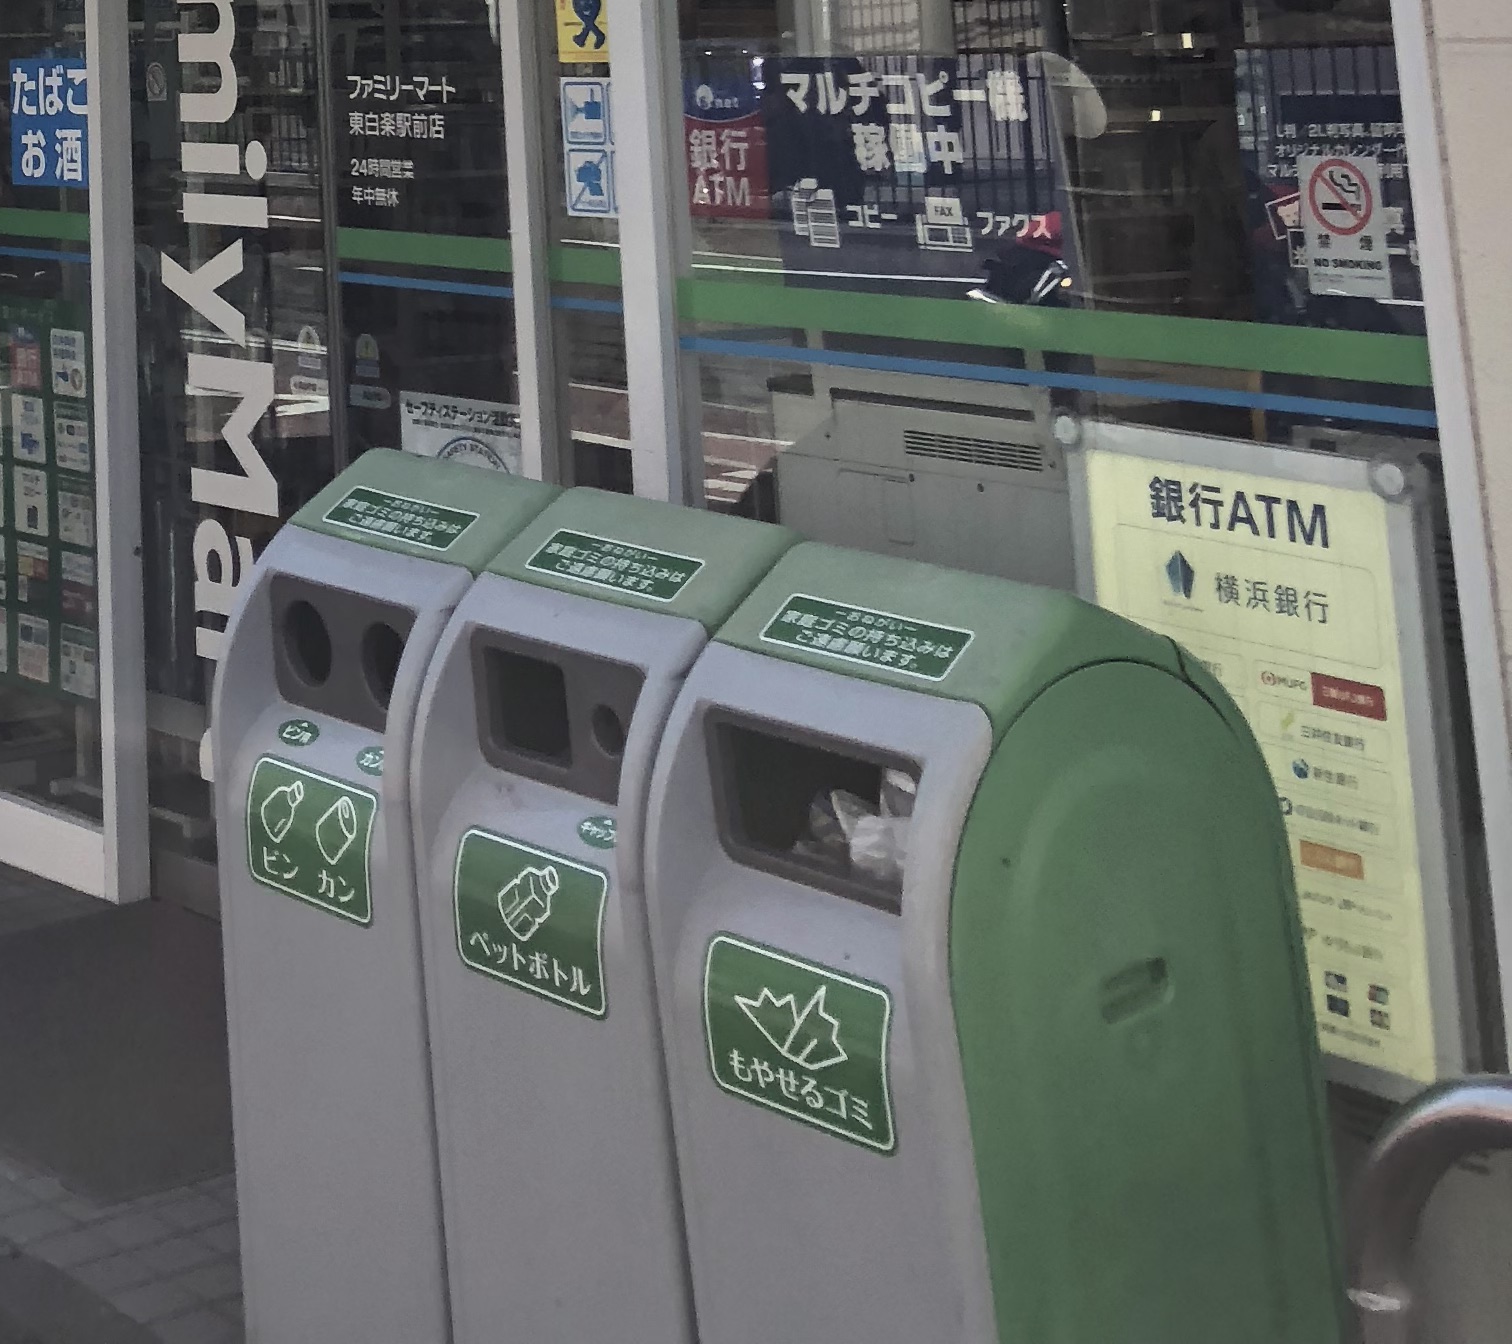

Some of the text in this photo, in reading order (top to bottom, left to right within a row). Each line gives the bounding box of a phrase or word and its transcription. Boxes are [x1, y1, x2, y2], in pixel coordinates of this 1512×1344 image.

[13, 64, 88, 116] たばこ
[346, 75, 456, 104] ファミリーマート
[779, 69, 1029, 123] マルチコピー機
[349, 111, 445, 140] 東白楽駅前店
[21, 129, 83, 182] お酒
[689, 128, 750, 173] 銀行
[851, 122, 965, 175] 稼働中
[350, 158, 415, 180] 24時間営業
[352, 186, 400, 208] 年中無休
[692, 175, 752, 207] ATM
[845, 204, 898, 230] コピー
[932, 204, 954, 218] FAX
[975, 211, 1053, 240] ファクス
[1313, 257, 1330, 269] NO
[1148, 475, 1330, 550] 銀行ATM
[1214, 571, 1329, 624] 横浜銀行
[317, 869, 356, 903] カン
[469, 931, 592, 996] ペットボトル
[728, 1047, 874, 1131] もやせるゴミ
